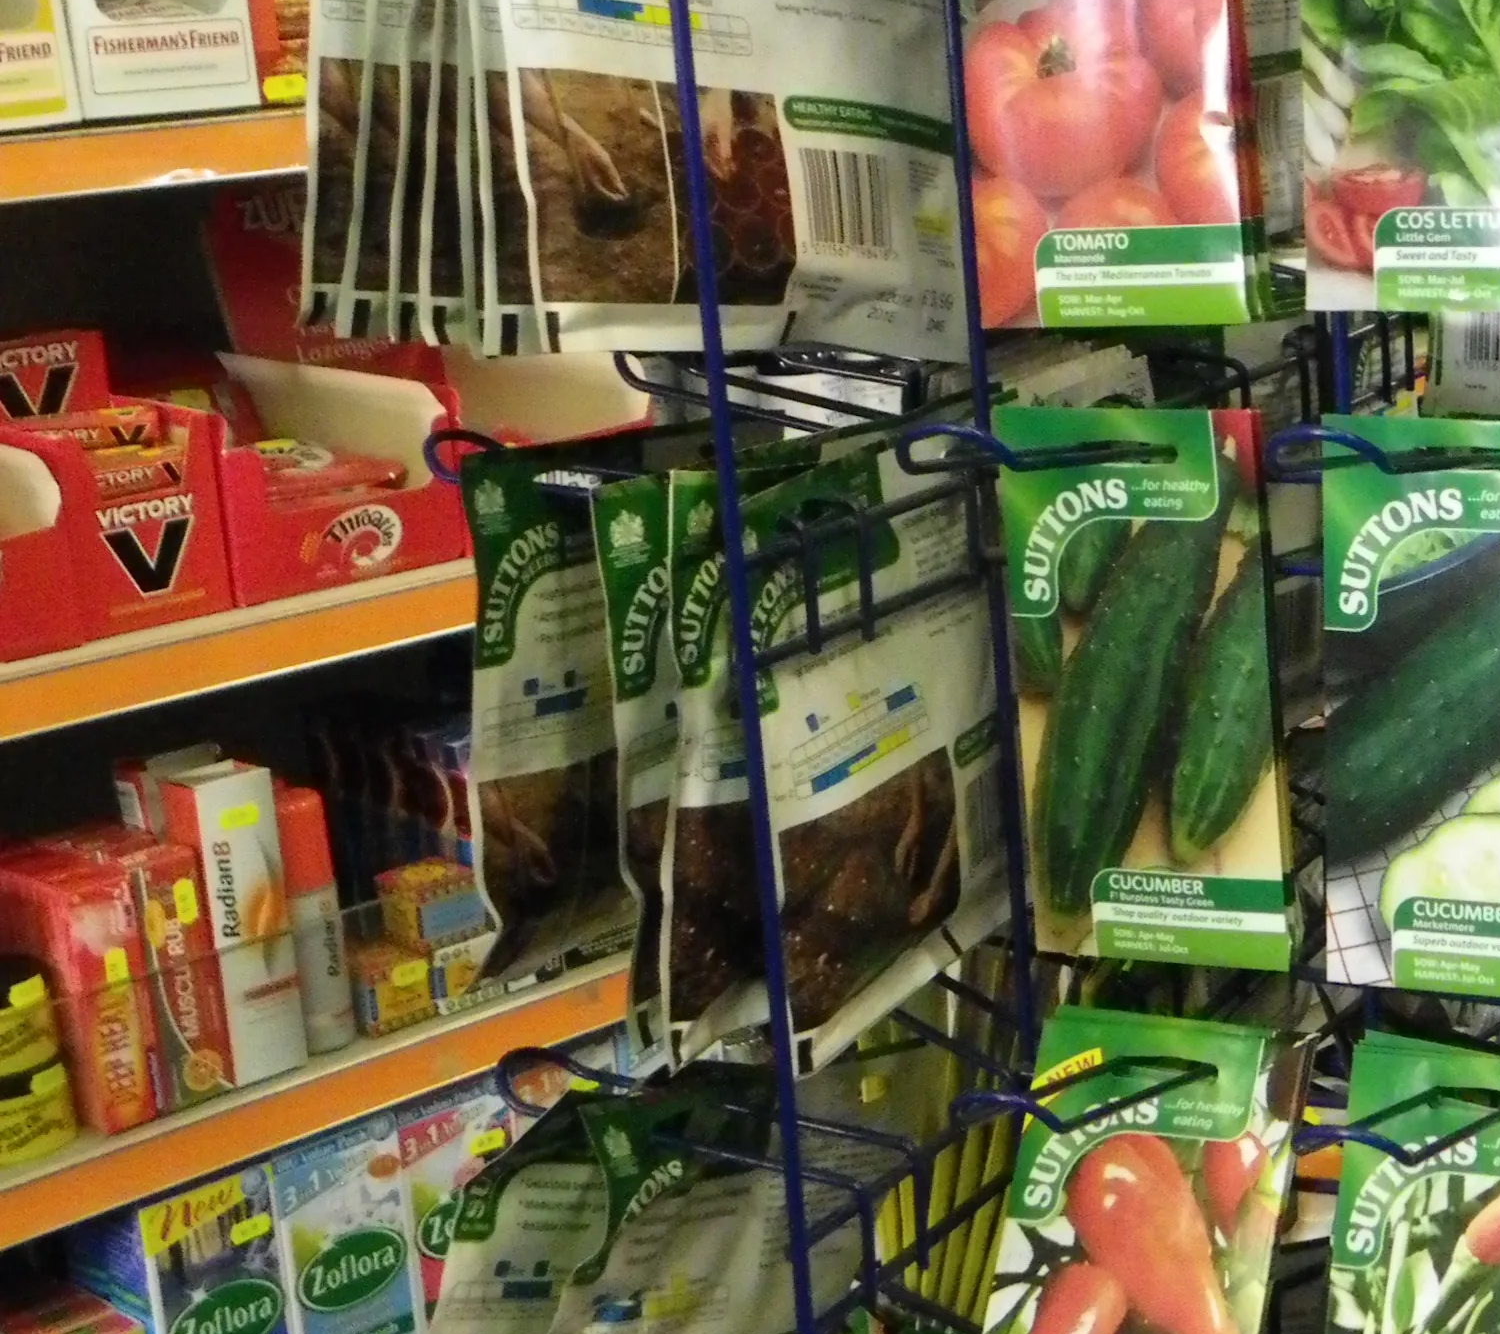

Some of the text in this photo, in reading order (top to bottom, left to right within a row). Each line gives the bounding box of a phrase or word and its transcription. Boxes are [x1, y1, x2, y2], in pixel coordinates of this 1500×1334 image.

[0, 41, 53, 61] FRIEND
[93, 29, 240, 55] FISHERMAN'S FRIEND
[1395, 212, 1436, 230] COS
[1053, 233, 1129, 252] TOMATO
[1395, 232, 1451, 243] Little Gem
[1395, 249, 1478, 264] Sweet and Tasty
[0, 363, 78, 419] V
[1131, 478, 1211, 494] ...for healthy
[1142, 498, 1184, 511] eating
[1467, 490, 1500, 504] ...for
[96, 493, 194, 529] VICTORY
[1023, 478, 1128, 602] SUTTONS
[101, 514, 195, 597] V
[1338, 487, 1464, 617] SUTTONS
[483, 521, 561, 646] SUTTONS
[1108, 873, 1205, 896] CUCUMBER
[1160, 895, 1186, 908] Tasty
[1186, 897, 1215, 908] Green
[1171, 912, 1245, 928] outdoor variety
[1412, 918, 1476, 934] Marketmore
[1412, 934, 1448, 950] Superb
[1449, 939, 1490, 952] outdoor
[1195, 1100, 1246, 1118] healthy
[1171, 1115, 1214, 1131] eating
[311, 1242, 395, 1298] Zoflora
